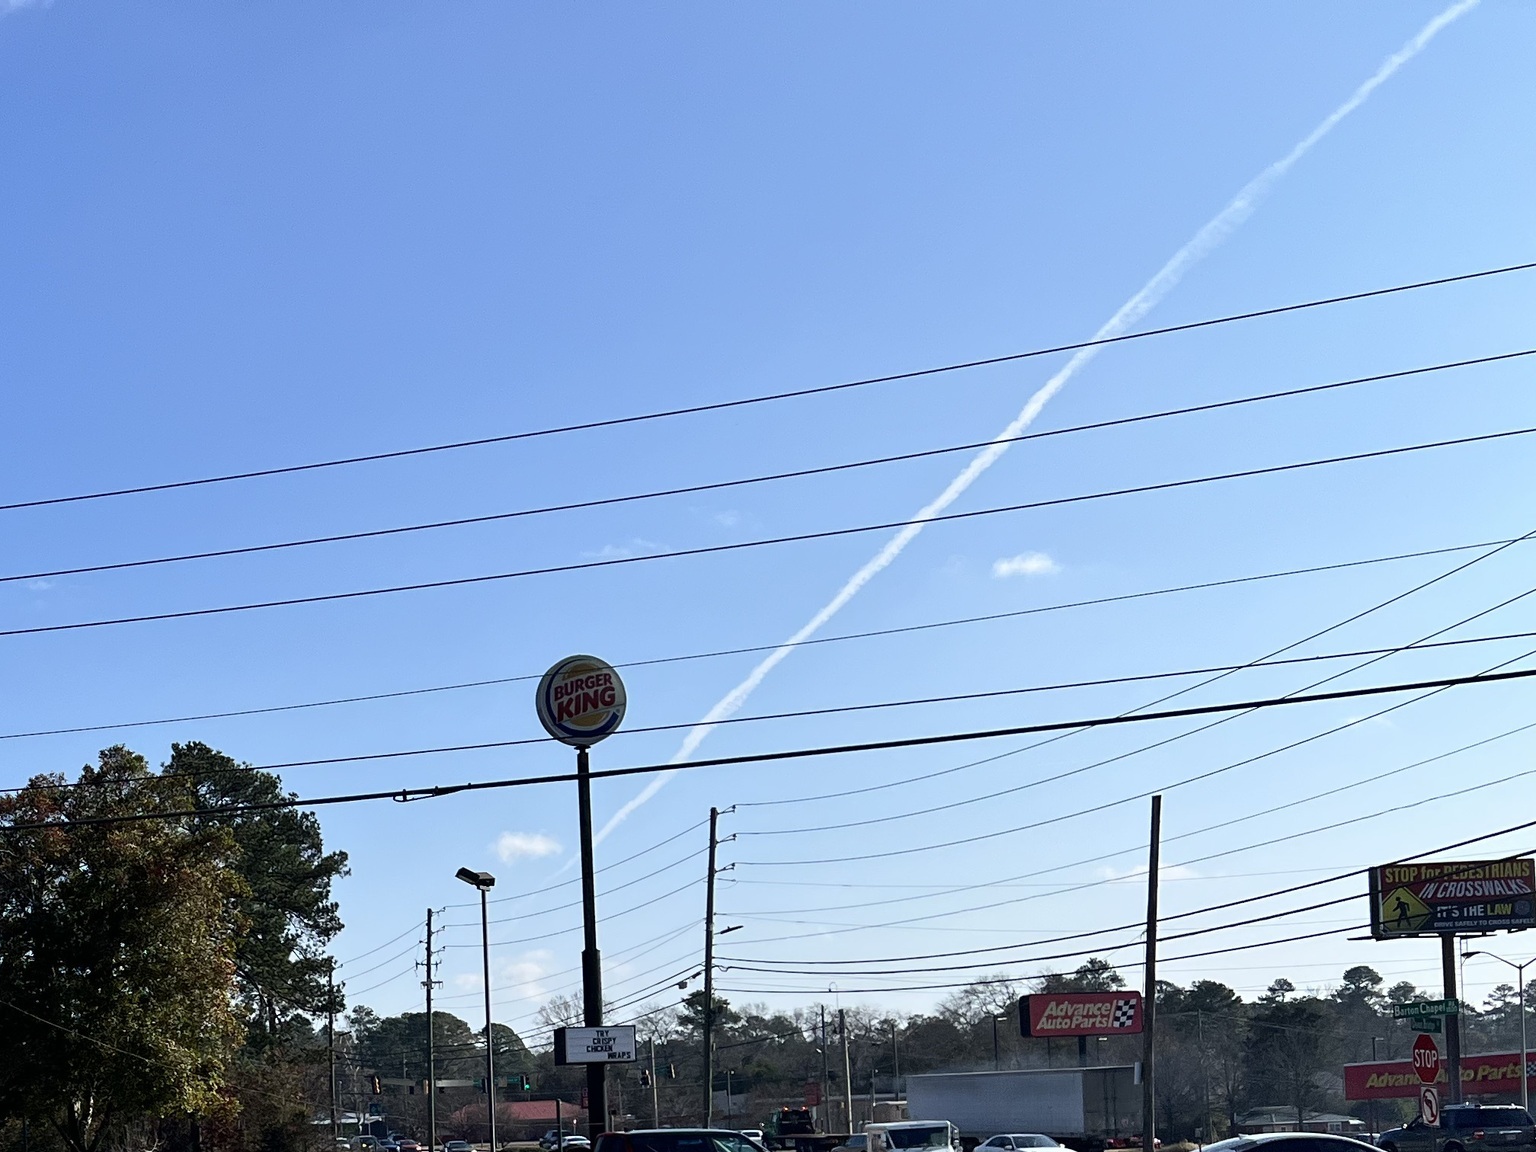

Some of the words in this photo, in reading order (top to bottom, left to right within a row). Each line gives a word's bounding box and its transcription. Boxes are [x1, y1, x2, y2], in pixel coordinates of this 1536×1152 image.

[554, 672, 613, 701] BURGER
[557, 686, 615, 723] KING
[1385, 866, 1418, 883] STOP
[1419, 882, 1438, 899] IN
[1437, 879, 1532, 898] CROSSWALKS
[1463, 904, 1485, 917] THE
[1487, 903, 1512, 916] LAW
[1044, 1001, 1111, 1017] Advance
[1394, 1005, 1420, 1017] Barton
[1420, 1003, 1445, 1014] Chapel
[1036, 1016, 1071, 1030] Auto
[1071, 1014, 1109, 1029] Parts
[592, 1037, 616, 1045] CRISPY
[1414, 1049, 1438, 1068] STOP
[1476, 1063, 1522, 1081] Parts
